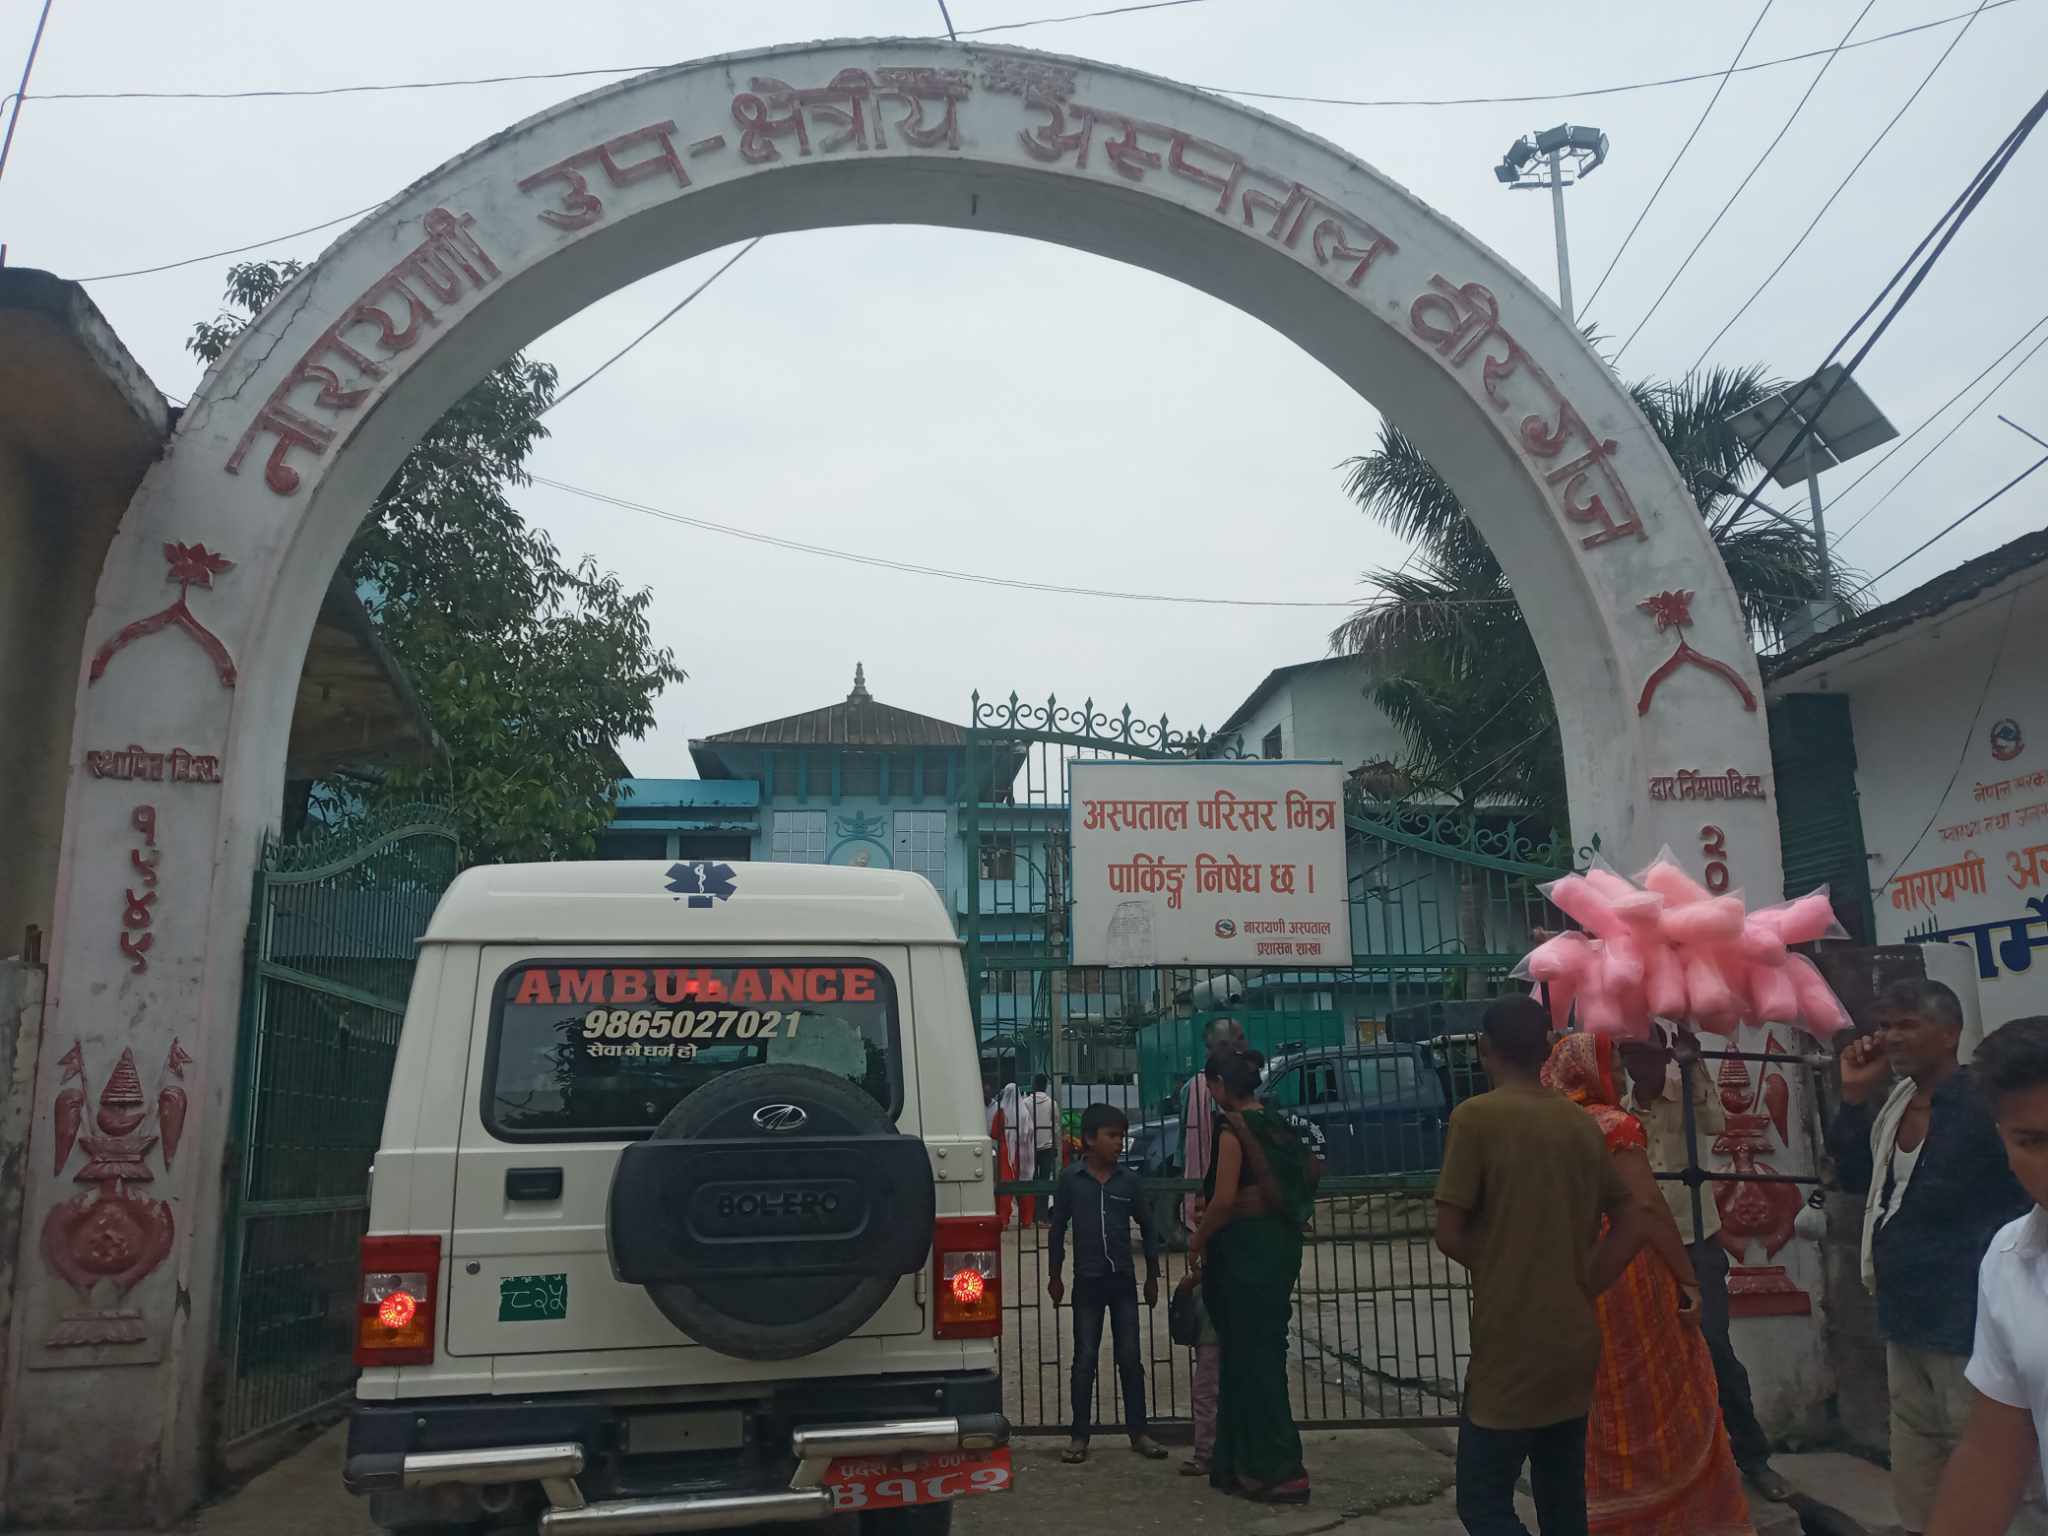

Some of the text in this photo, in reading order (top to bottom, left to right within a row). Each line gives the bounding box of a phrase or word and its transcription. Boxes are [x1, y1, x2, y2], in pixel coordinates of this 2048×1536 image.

[224, 207, 501, 496] नारायणी
[1018, 98, 1399, 288] अस्पताल
[1082, 789, 1336, 832] अस्पताल परिसर भित्र
[1195, 853, 1262, 894] निषेध
[1270, 863, 1297, 895] छ
[1890, 849, 1987, 914] नारायणी
[1243, 918, 1331, 936] नारायणी अस्पताल
[514, 967, 877, 1005] AMBULANCE
[582, 1009, 803, 1039] 9865027021
[586, 1042, 623, 1058] सेवा
[676, 1042, 699, 1059] हो
[717, 1191, 839, 1218] BOLERO
